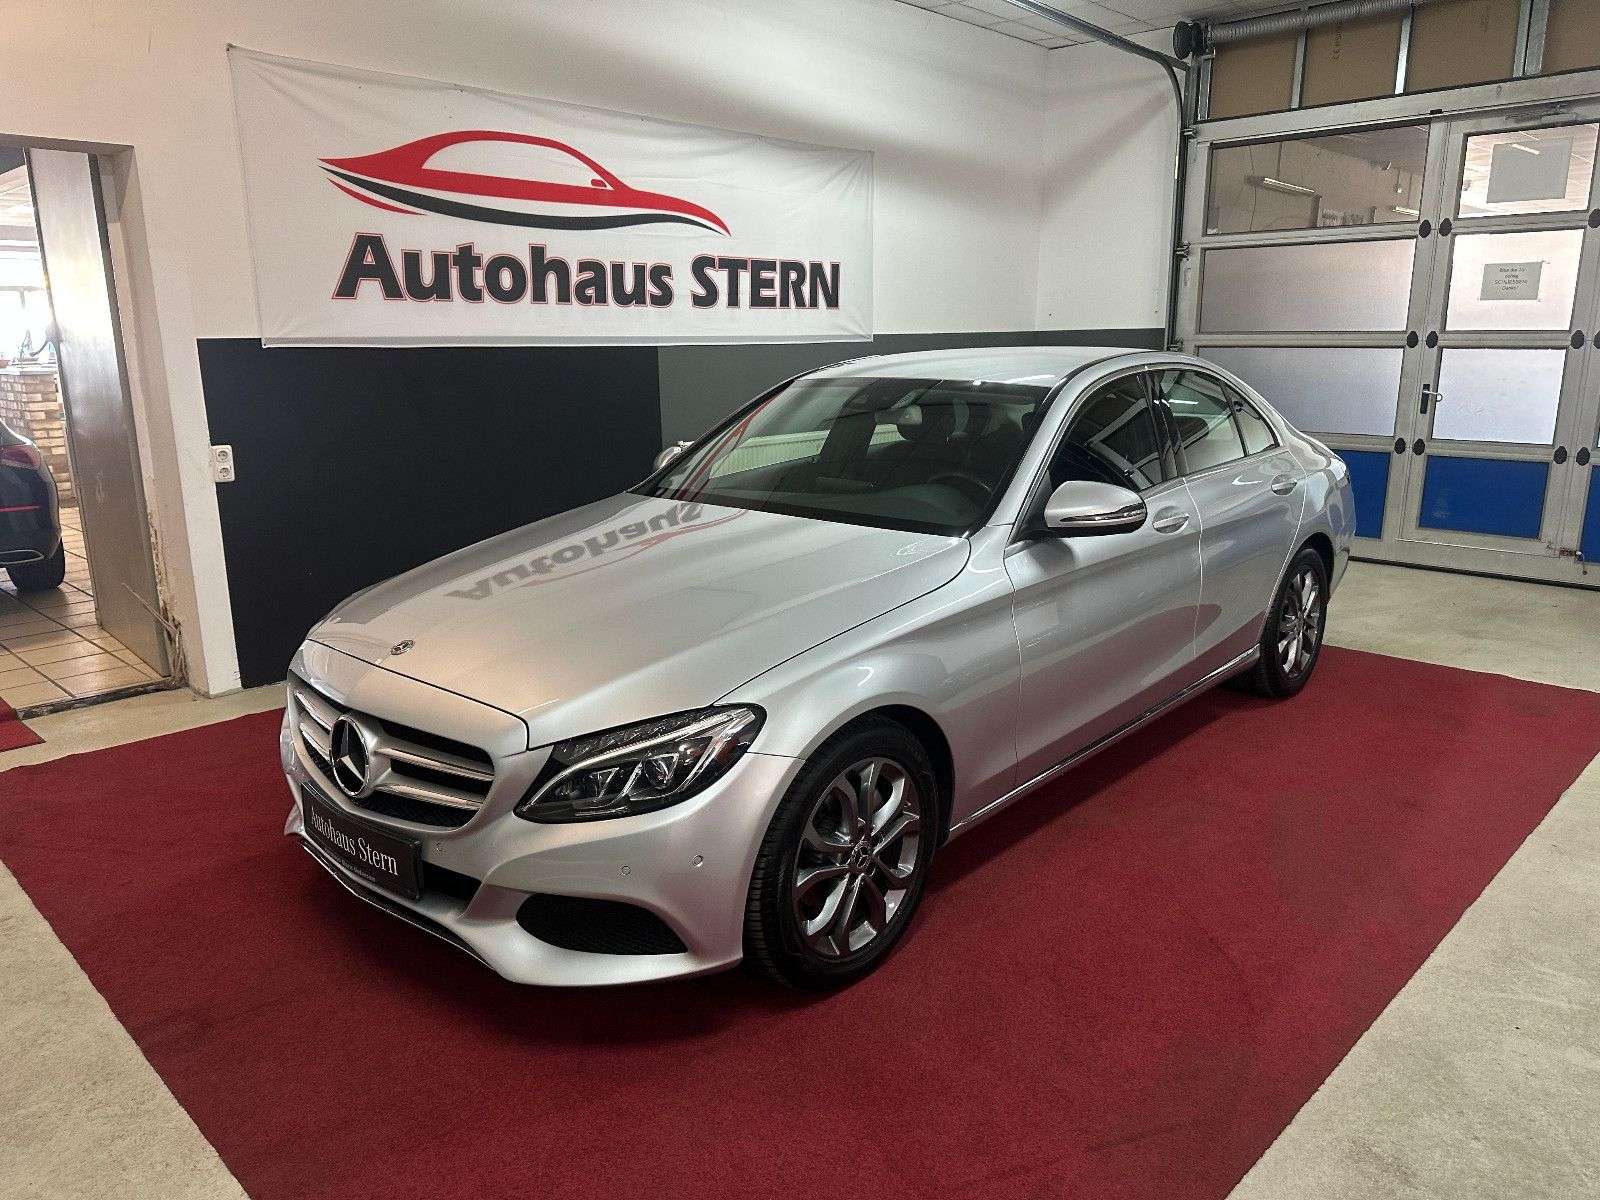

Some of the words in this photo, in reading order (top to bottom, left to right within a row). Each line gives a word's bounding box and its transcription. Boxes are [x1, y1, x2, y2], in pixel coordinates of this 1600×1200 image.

[331, 231, 674, 308] Autohaus
[690, 253, 841, 310] STERN
[312, 806, 356, 856] Autohaus
[358, 837, 399, 876] Stern
